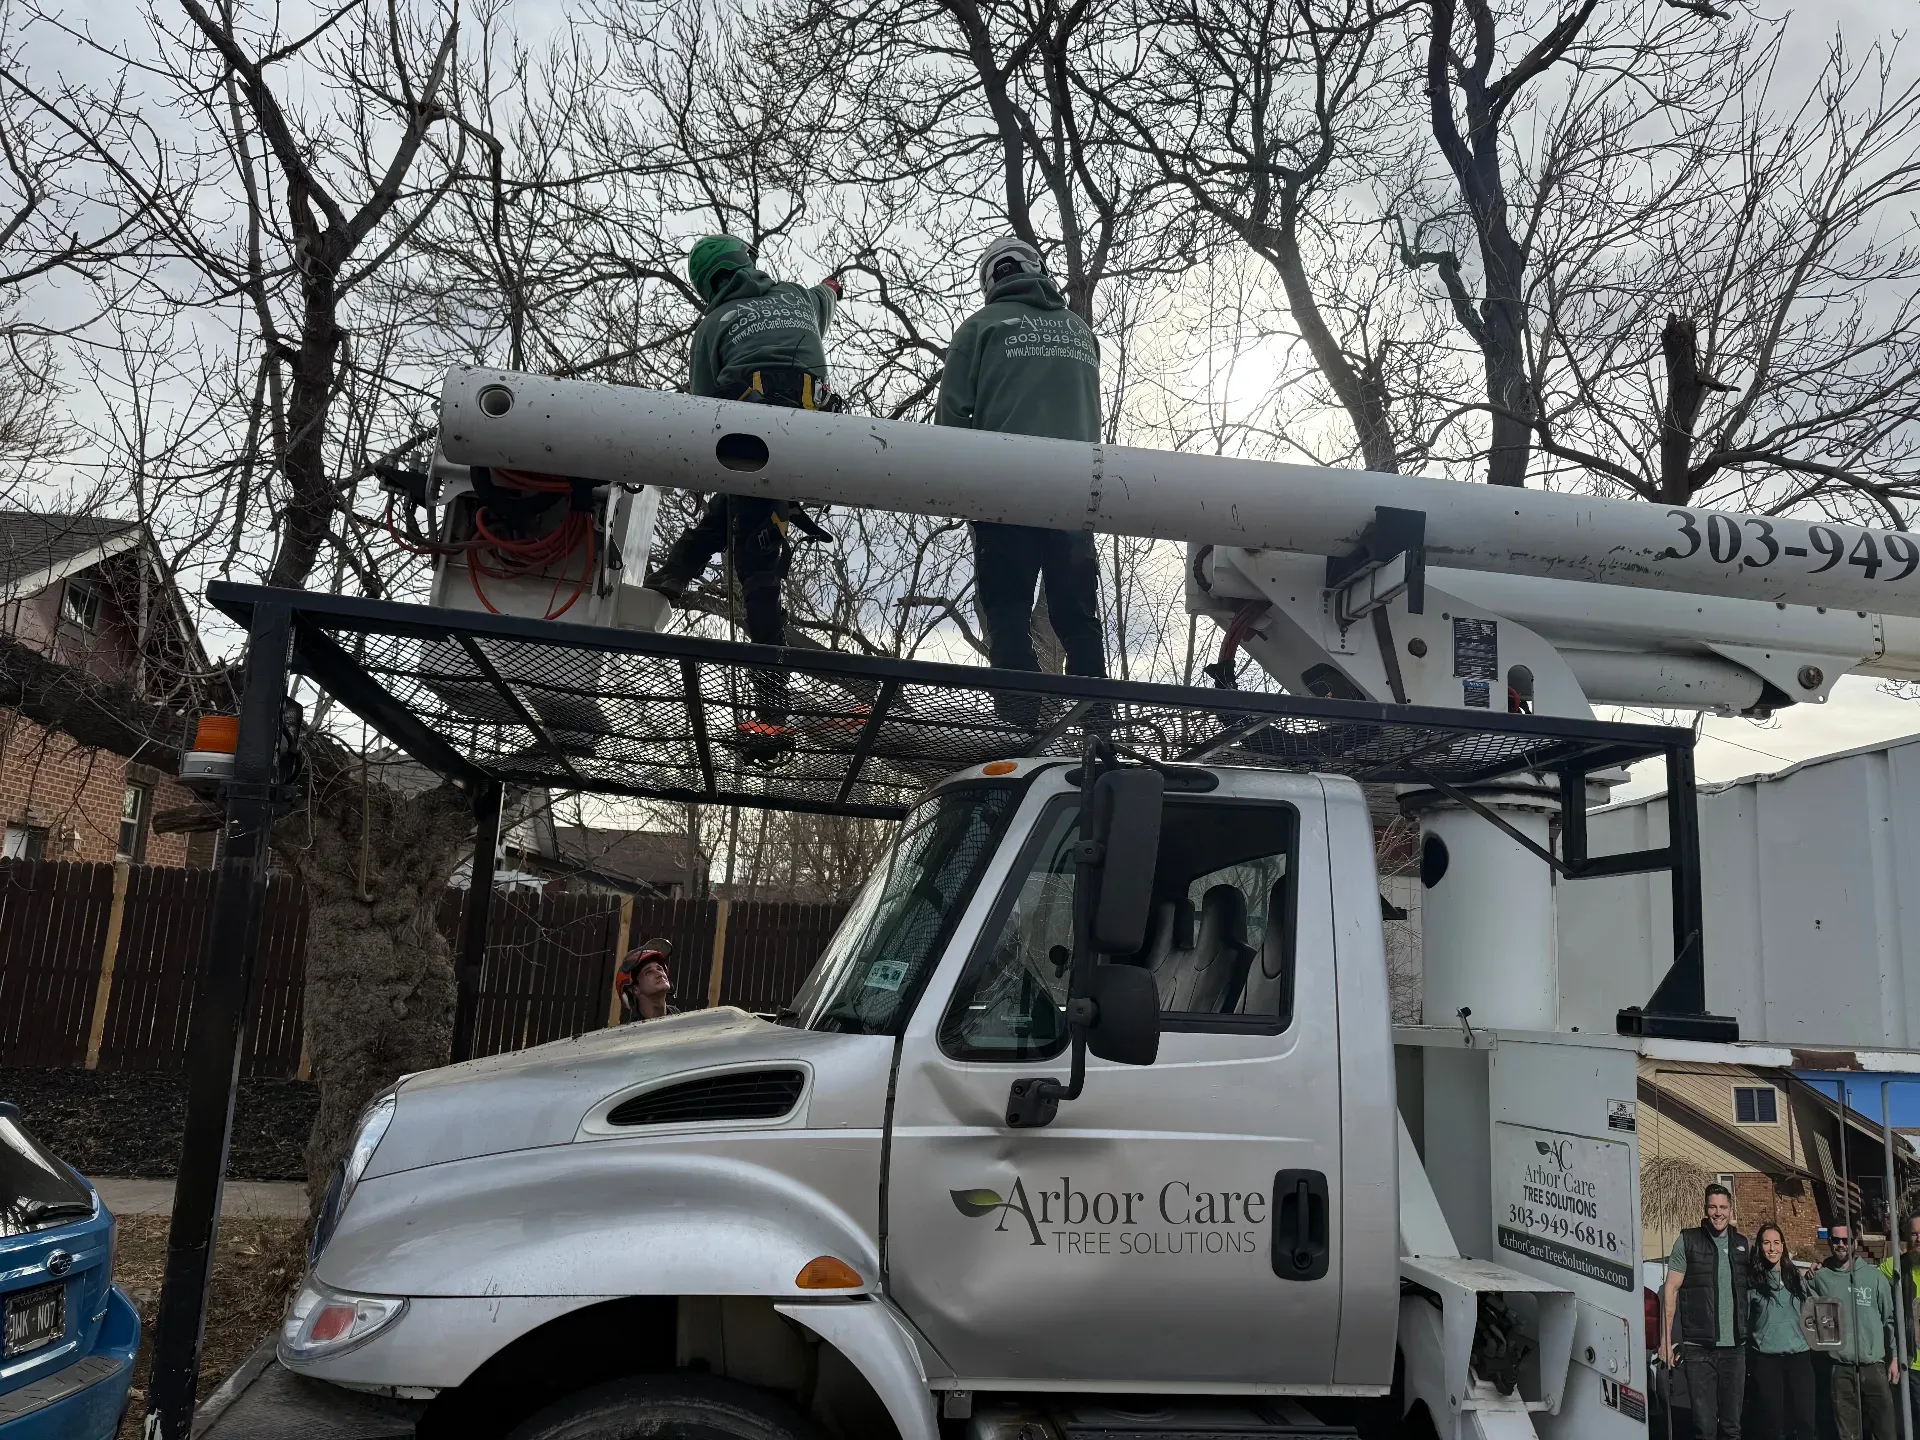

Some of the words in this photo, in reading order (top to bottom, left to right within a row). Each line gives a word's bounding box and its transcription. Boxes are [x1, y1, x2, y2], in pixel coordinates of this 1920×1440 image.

[728, 310, 761, 336] (303)
[762, 308, 815, 322] 949-68
[736, 296, 779, 317] Arbor
[1020, 314, 1063, 332] Arbor
[1004, 333, 1041, 346] (303)
[1664, 509, 1920, 582] 303-949
[1524, 1164, 1561, 1190] Arbor
[1564, 1171, 1596, 1198] Care
[994, 1175, 1145, 1246] Arbor
[1159, 1180, 1266, 1225] Care
[1523, 1185, 1544, 1205] TREE
[1545, 1190, 1597, 1219] SOLUTIONS
[1052, 1231, 1111, 1254] TREE
[1119, 1231, 1256, 1254] SOLUTIONS
[1509, 1203, 1617, 1252] 303-949-6818
[1502, 1232, 1629, 1288] ArborCareTreeSolutions.com
